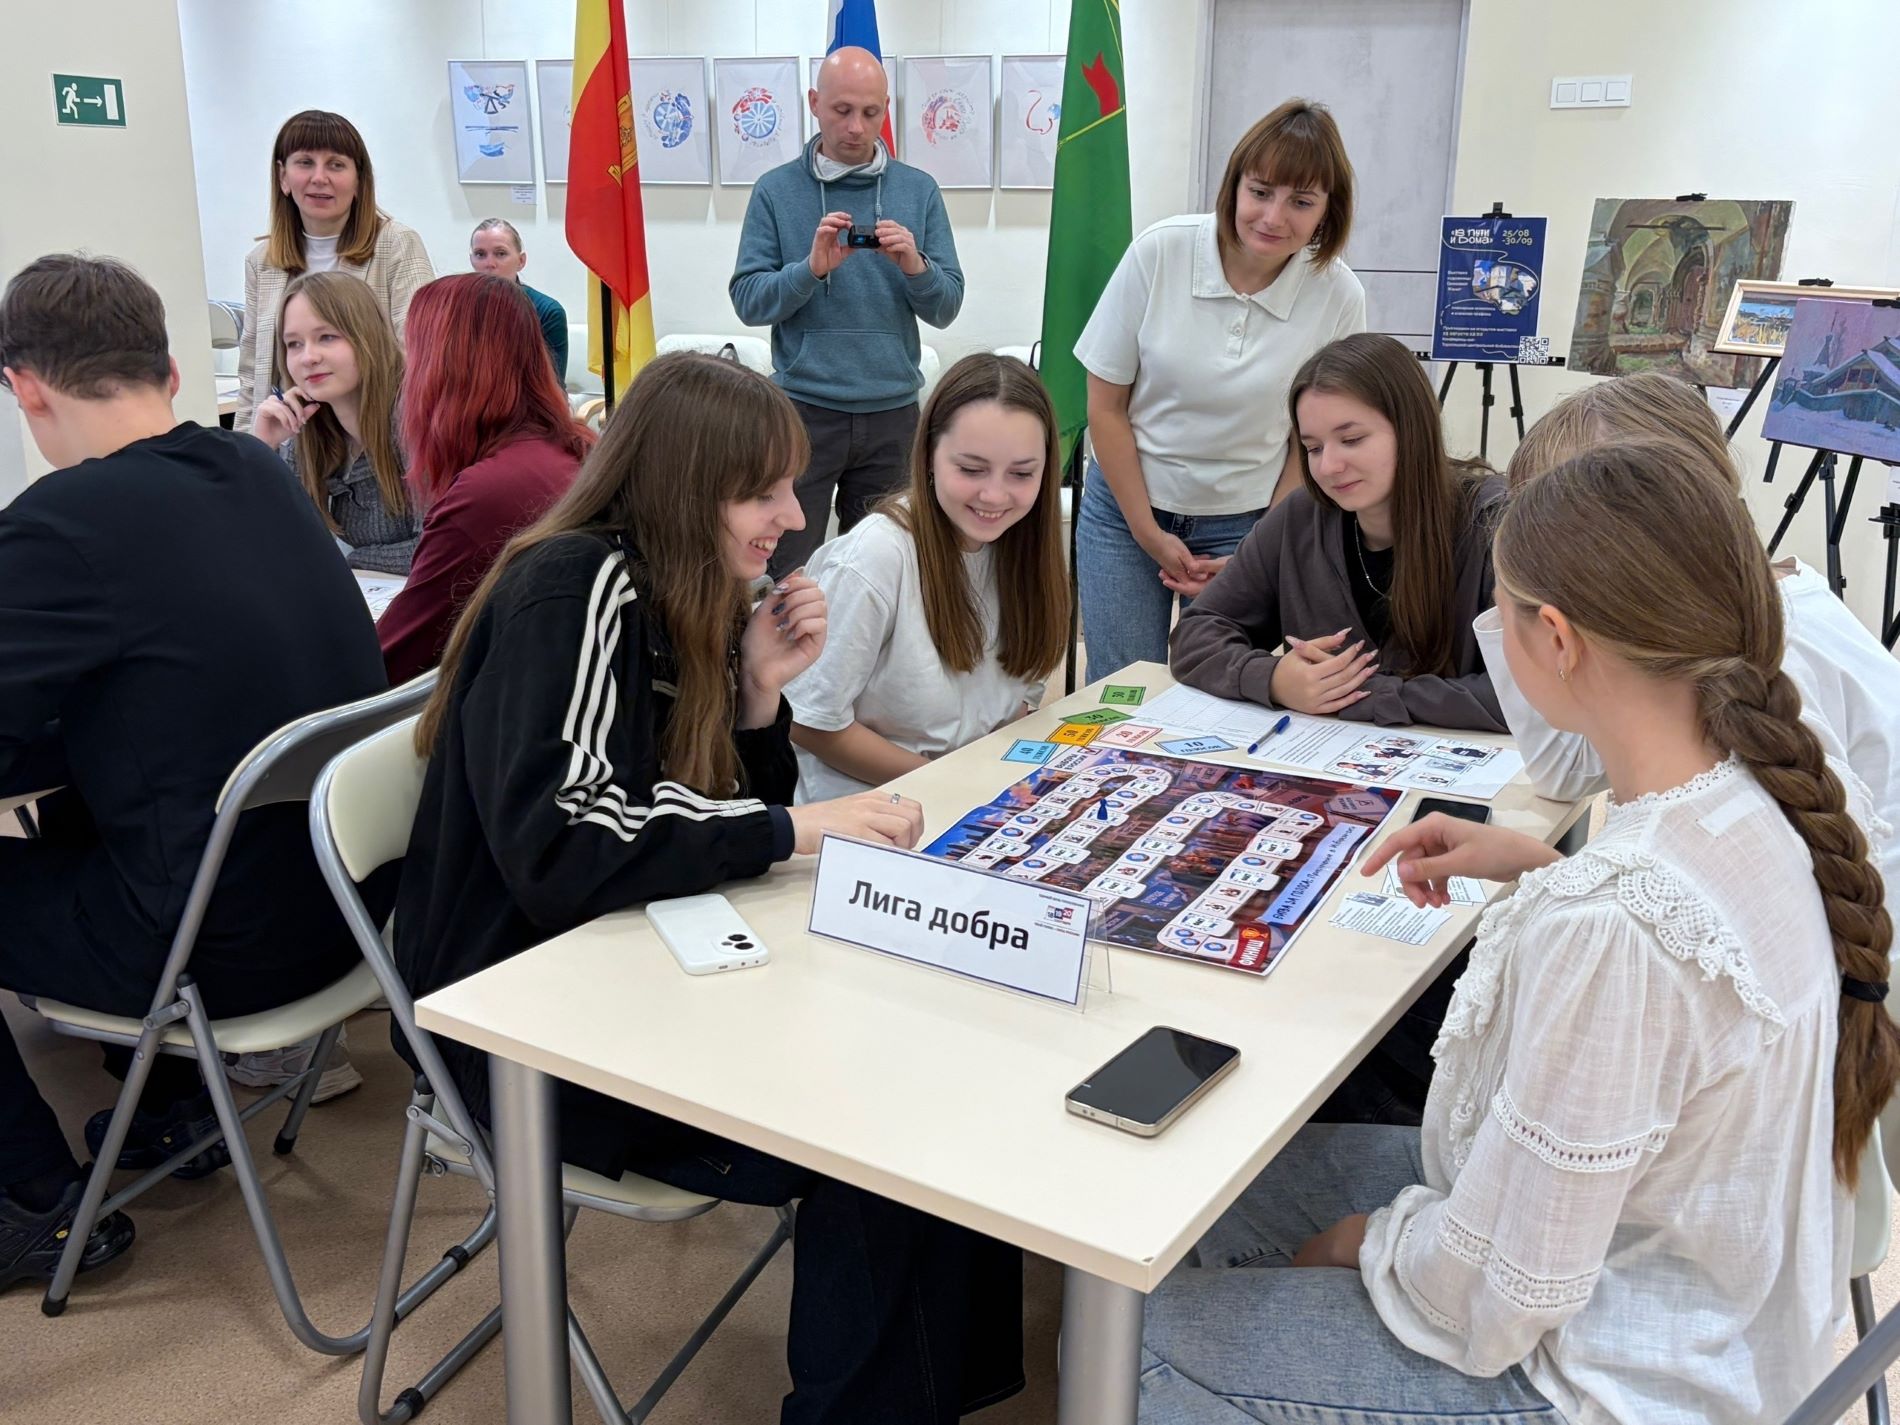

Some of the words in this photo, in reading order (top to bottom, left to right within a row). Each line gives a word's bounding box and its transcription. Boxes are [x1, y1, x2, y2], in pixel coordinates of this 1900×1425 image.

[1502, 229, 1530, 237] 25/08
[1063, 729, 1080, 738] 50
[1183, 740, 1205, 748] 10
[1019, 747, 1034, 756] 40
[848, 880, 922, 922] Лига
[928, 910, 1030, 951] добра
[1238, 940, 1265, 966] ФИНИШ
